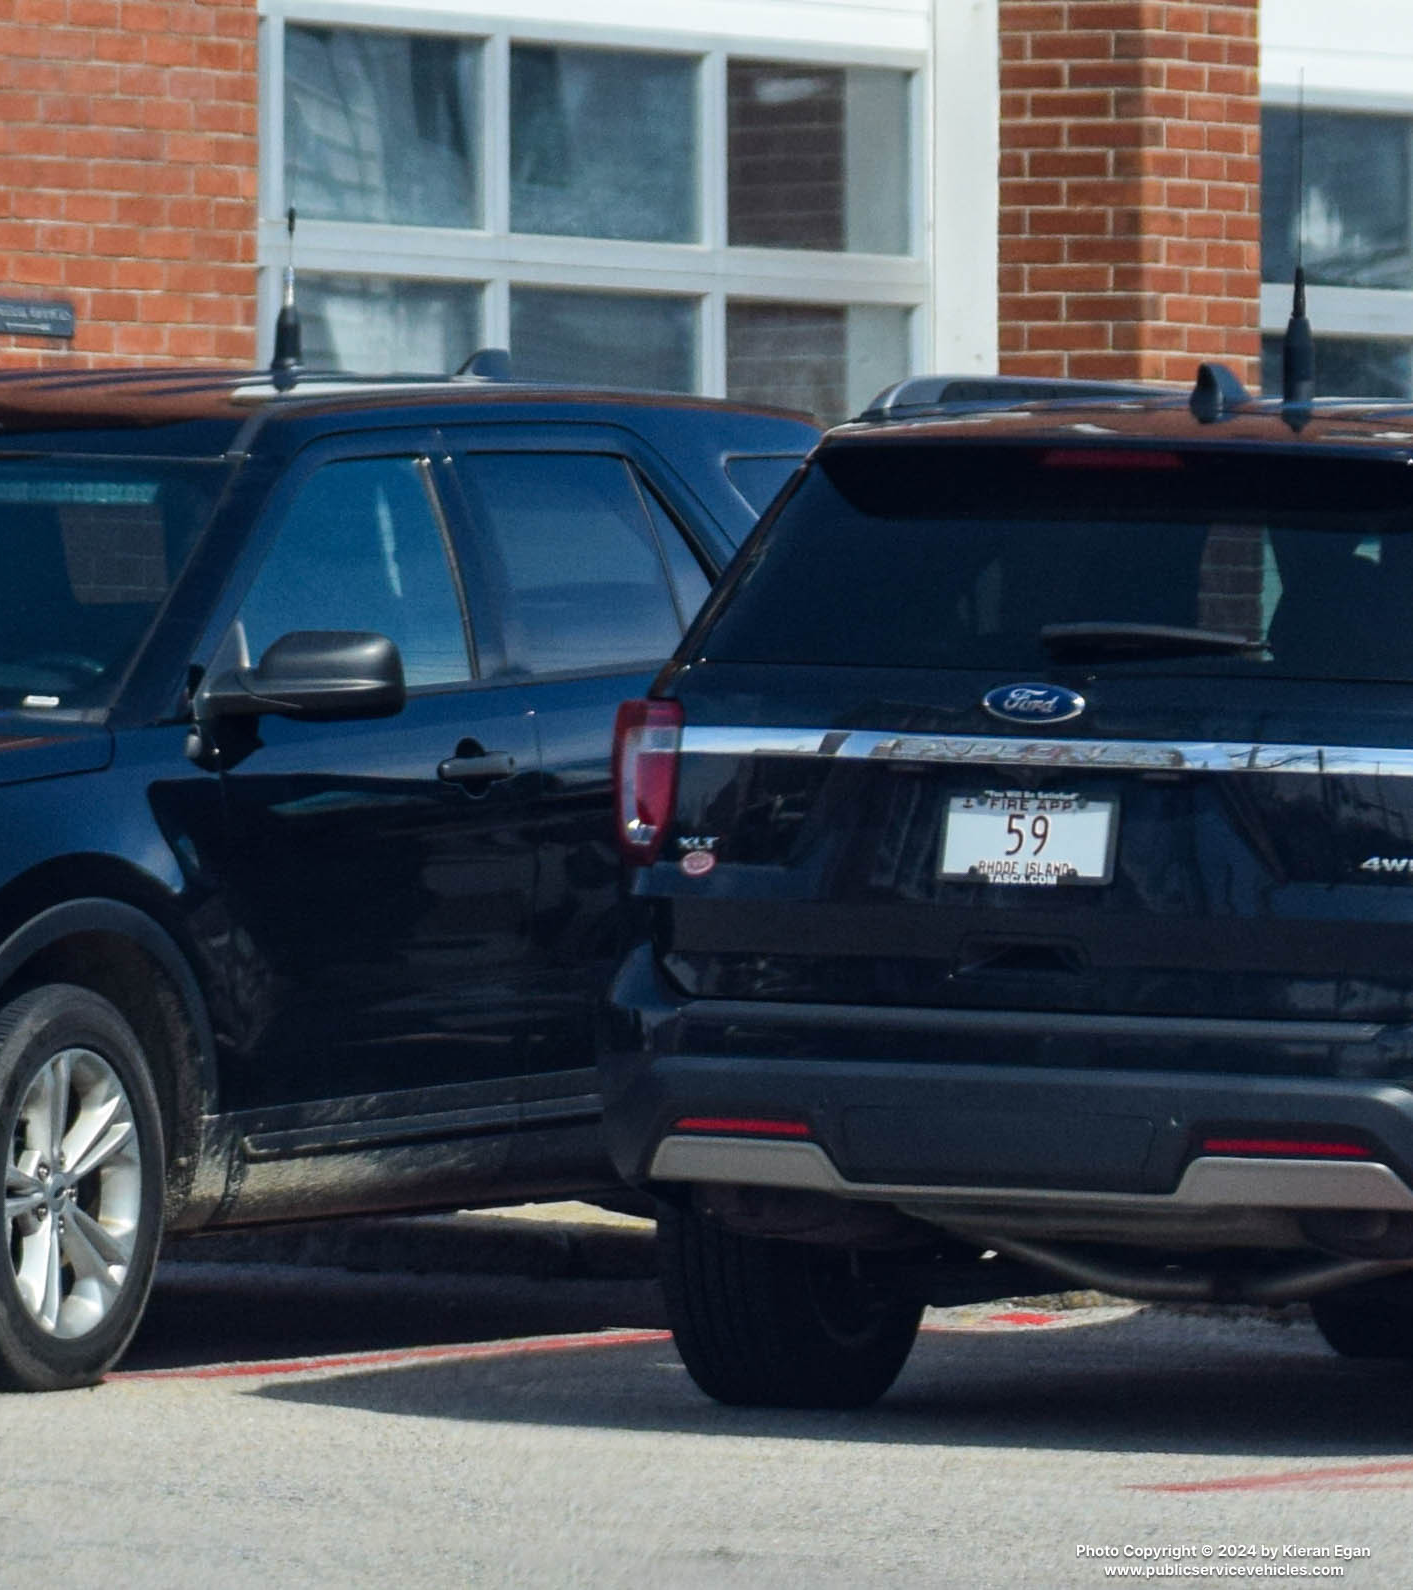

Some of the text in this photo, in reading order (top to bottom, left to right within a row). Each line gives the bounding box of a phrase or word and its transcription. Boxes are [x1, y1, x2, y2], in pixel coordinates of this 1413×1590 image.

[1004, 688, 1060, 713] Ford
[989, 799, 1029, 811] FIRE
[1005, 814, 1049, 856] 59
[677, 836, 720, 849] XLT
[978, 860, 1070, 876] RHODE ISLAND
[1359, 857, 1413, 871] 4W
[988, 874, 1058, 885] TASCA.COM
